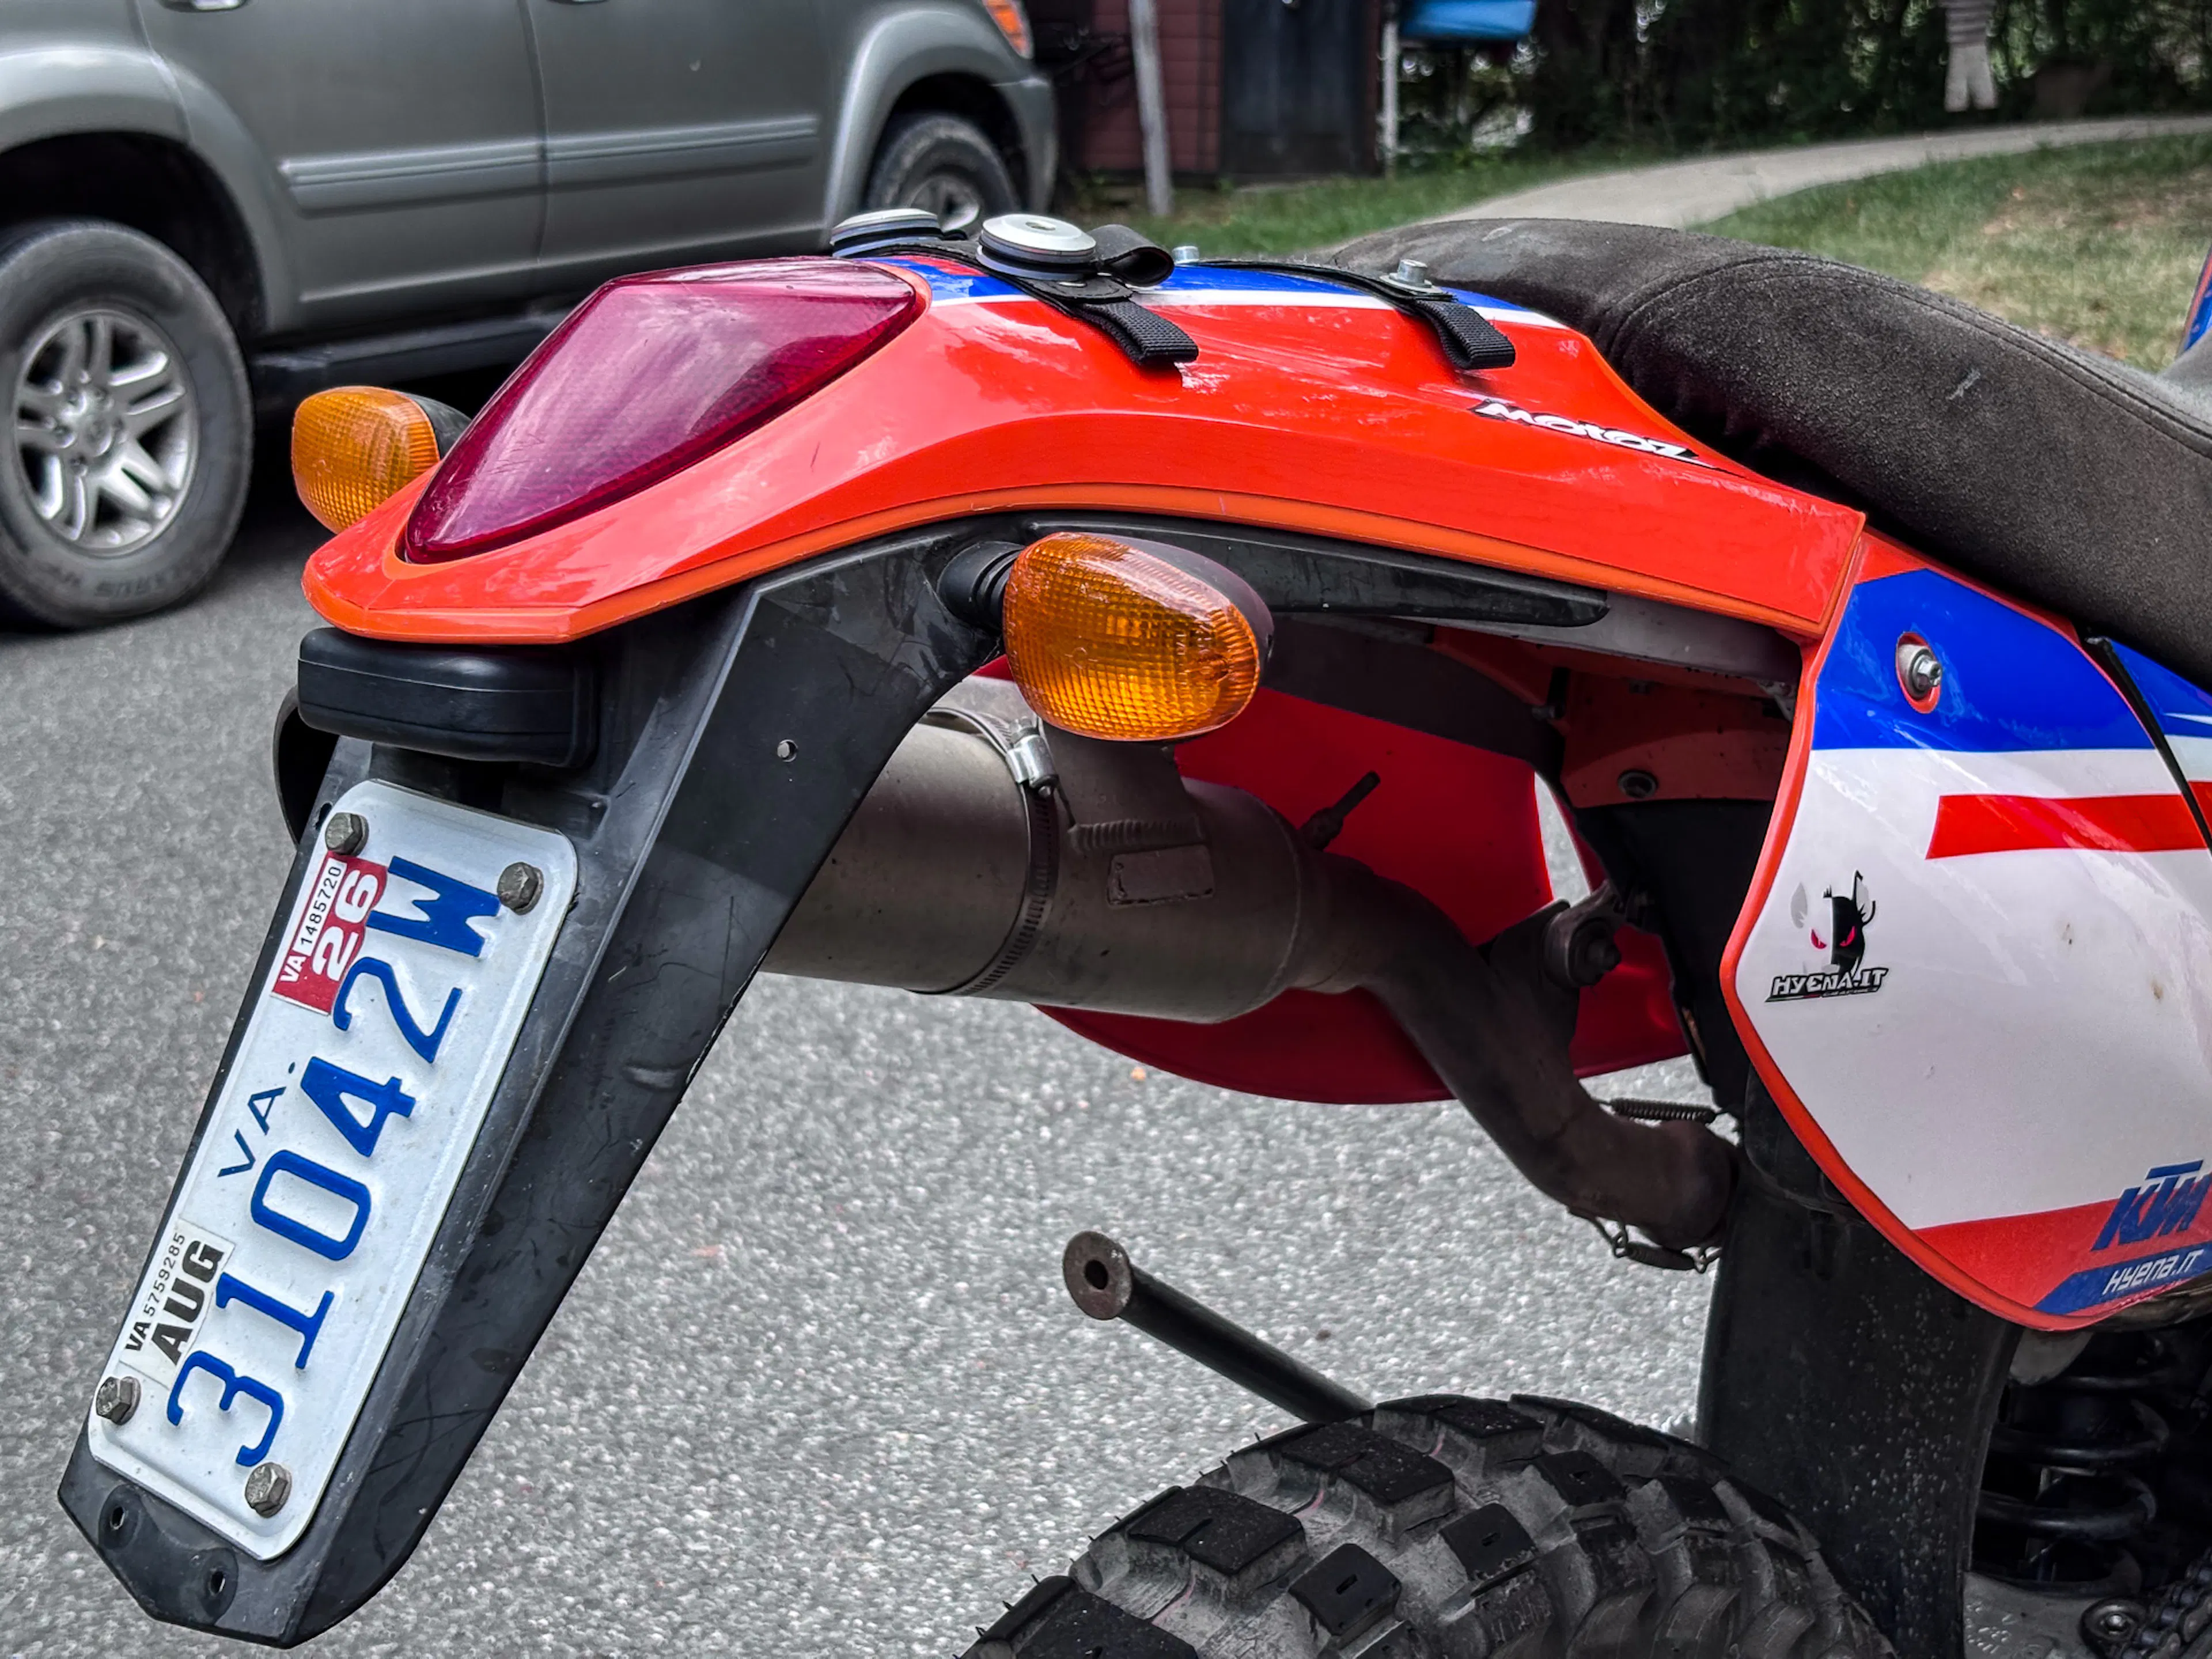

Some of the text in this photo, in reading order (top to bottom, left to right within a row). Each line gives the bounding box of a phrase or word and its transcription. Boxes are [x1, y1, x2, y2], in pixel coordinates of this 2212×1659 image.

[280, 865, 343, 984] VA 1485720
[311, 869, 379, 982] 26
[1770, 968, 1888, 997] HYENA.IT
[167, 855, 502, 1467] 31042W
[2090, 1159, 2212, 1252] KTM
[124, 1233, 185, 1353] VA 5759285
[150, 1240, 225, 1366] AUG
